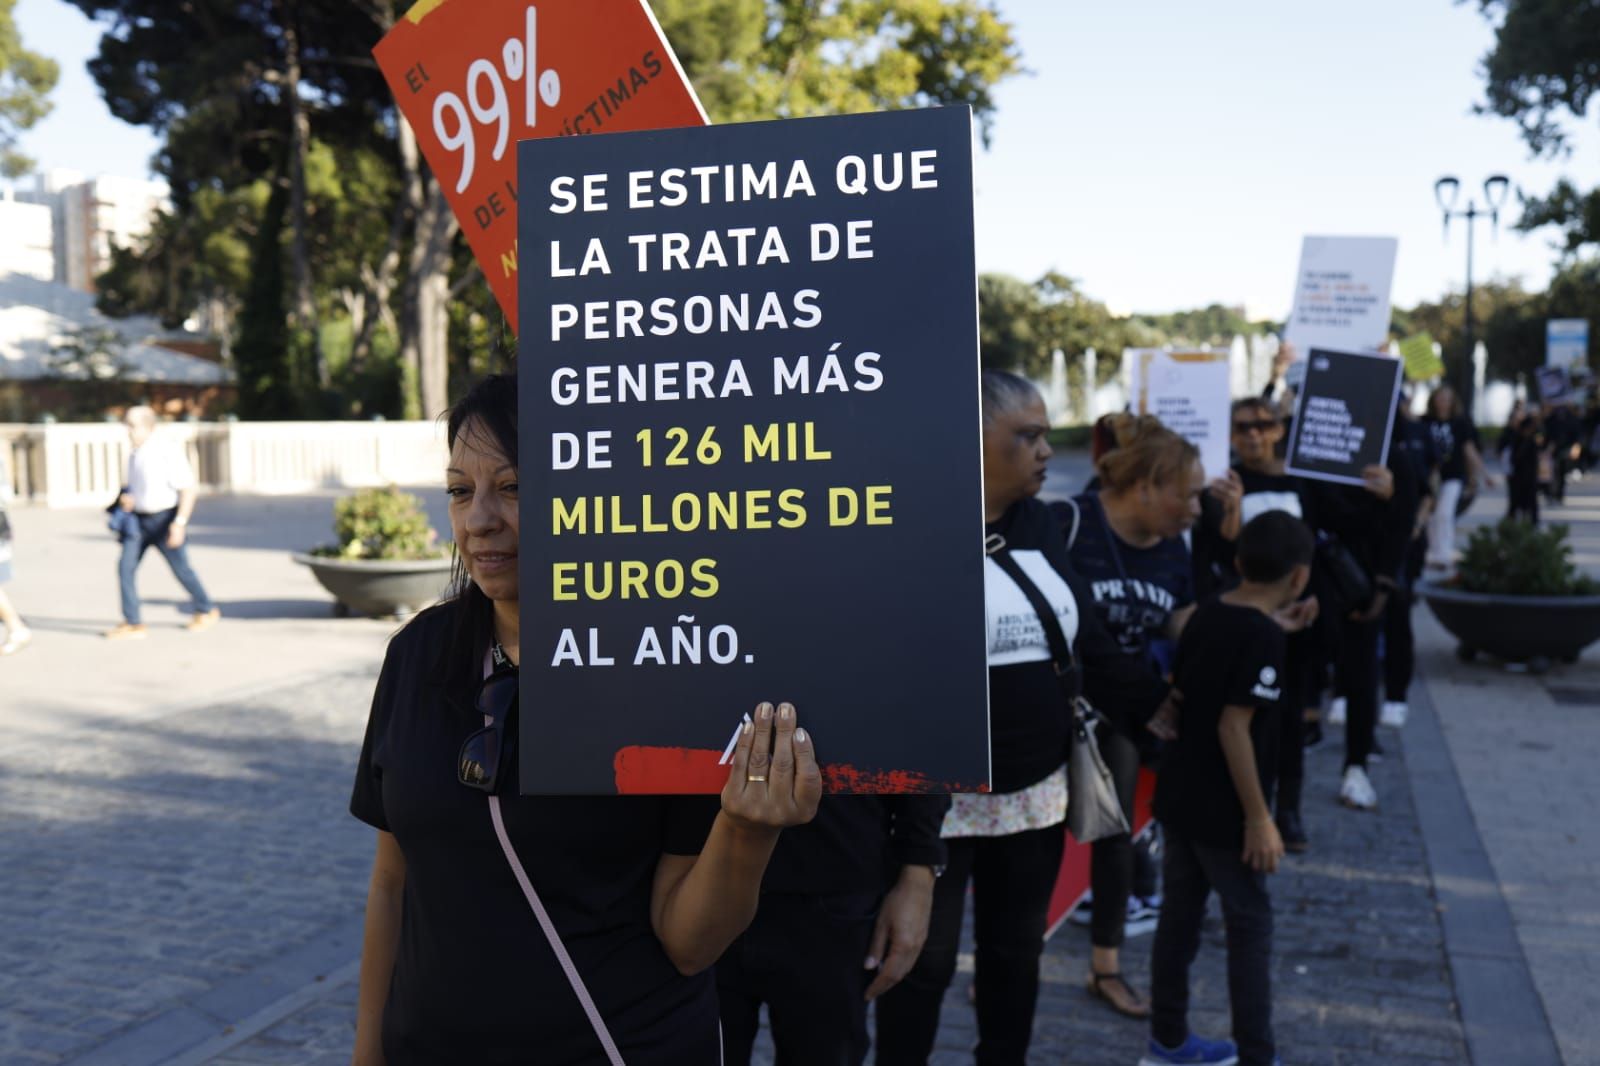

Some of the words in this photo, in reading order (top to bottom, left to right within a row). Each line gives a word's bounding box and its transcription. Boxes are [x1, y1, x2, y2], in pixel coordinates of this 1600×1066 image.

[432, 5, 561, 195] 99%
[473, 191, 507, 231] DE
[559, 50, 663, 136] ÍCTIMAS
[549, 173, 609, 214] SE
[628, 159, 817, 209] ESTIMA
[835, 149, 938, 196] QUE
[550, 237, 612, 278] LA
[628, 225, 790, 273] TRATA
[810, 219, 874, 262] DE
[551, 288, 822, 342] PERSONAS
[550, 359, 753, 406] GENERA
[773, 343, 884, 396] MÁS
[552, 430, 612, 471] DE
[636, 425, 722, 467] 126
[743, 421, 832, 463] MIL
[552, 488, 807, 536] MILLONES
[828, 485, 893, 527] DE
[552, 558, 719, 601] EUROS
[551, 627, 615, 667] AL
[633, 614, 754, 665] AÑO.
